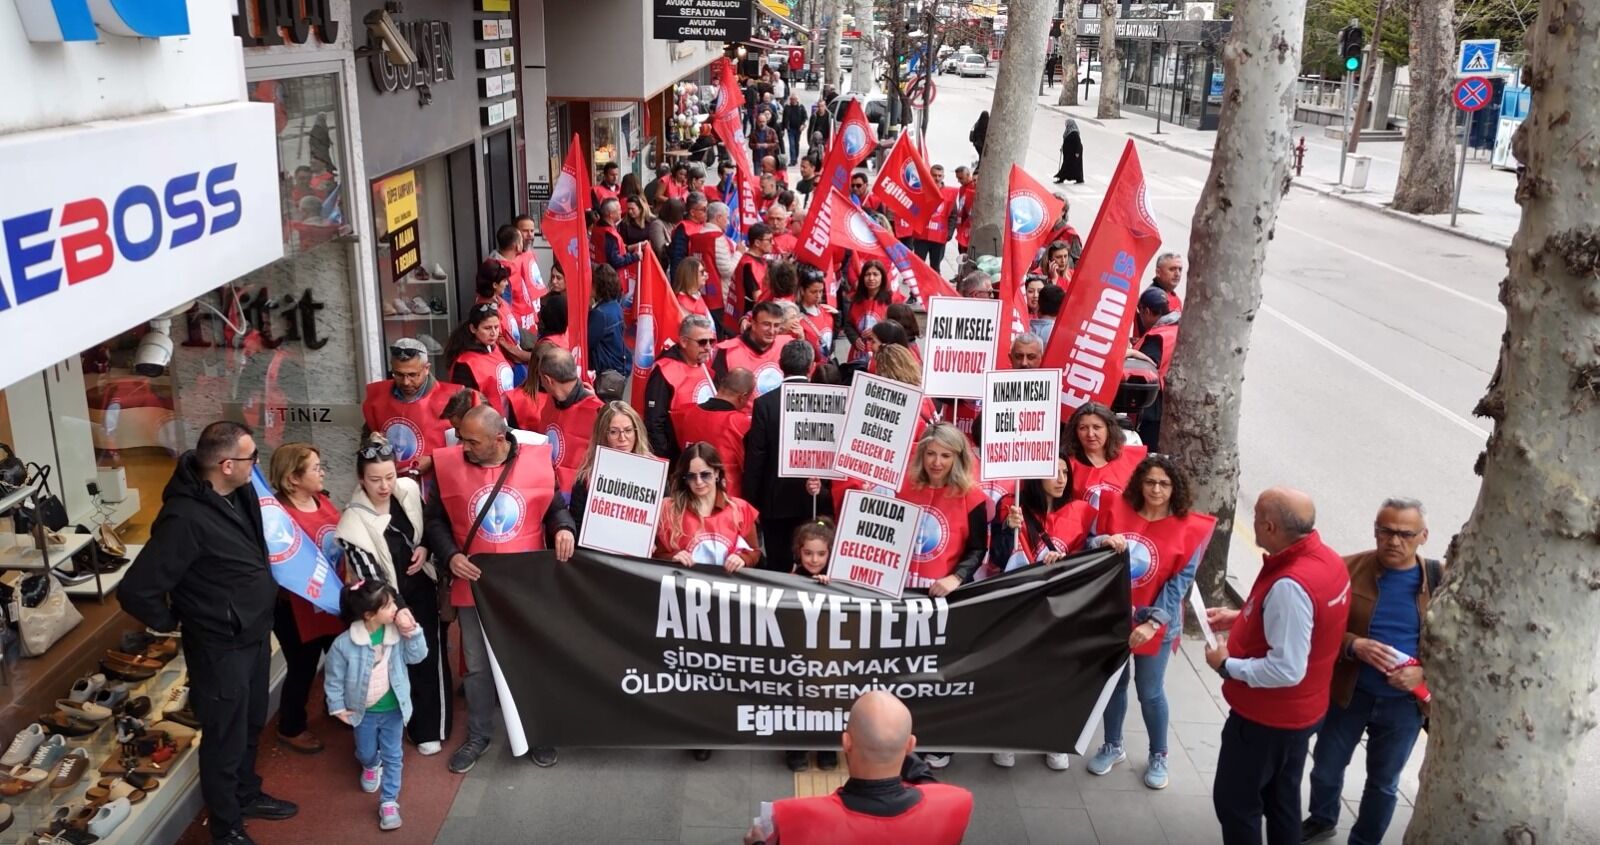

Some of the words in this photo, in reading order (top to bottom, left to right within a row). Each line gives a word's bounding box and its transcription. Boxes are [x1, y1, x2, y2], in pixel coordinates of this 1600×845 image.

[680, 8, 702, 17] SEFA
[703, 9, 726, 17] UYAN
[696, 0, 740, 8] ARABULUCU
[678, 27, 702, 35] CENK
[704, 28, 727, 36] UYAN
[931, 316, 953, 340] ASIL
[954, 318, 994, 342] MESELE:
[933, 346, 987, 374] ÖLÜYORUZ!
[864, 381, 908, 408] ÖĞRETMEN
[992, 381, 1022, 403] KINAMA
[1023, 380, 1051, 402] MESAJI
[864, 402, 901, 425] GÜVENDE
[995, 408, 1018, 434] DEĞİL,
[1018, 407, 1046, 436] ŞİDDET
[860, 421, 894, 443] DEĞİLSE
[850, 438, 884, 461] GELECEK
[884, 449, 896, 464] DE
[986, 441, 1012, 464] YASASI
[1012, 438, 1054, 462] İSTİYORUZ!
[837, 453, 873, 477] GÜVENDE
[872, 465, 900, 486] DEĞİL!
[596, 473, 658, 505] ÖLDÜRÜRSEN
[590, 496, 653, 527] ÖĞRETEMEM...
[859, 496, 906, 523] OKULDA
[855, 519, 896, 546] HUZUR,
[840, 540, 902, 570] GELECEKTE
[849, 565, 885, 587] UMUT
[655, 574, 786, 648] ARTIK
[796, 590, 950, 650] YETER!
[663, 646, 766, 670] ŞİDDETE
[769, 654, 901, 678] UĞRAMAK
[905, 654, 939, 674] VE
[620, 667, 794, 697] ÖLDÜRÜLMEK
[736, 704, 852, 736] Eğitimi
